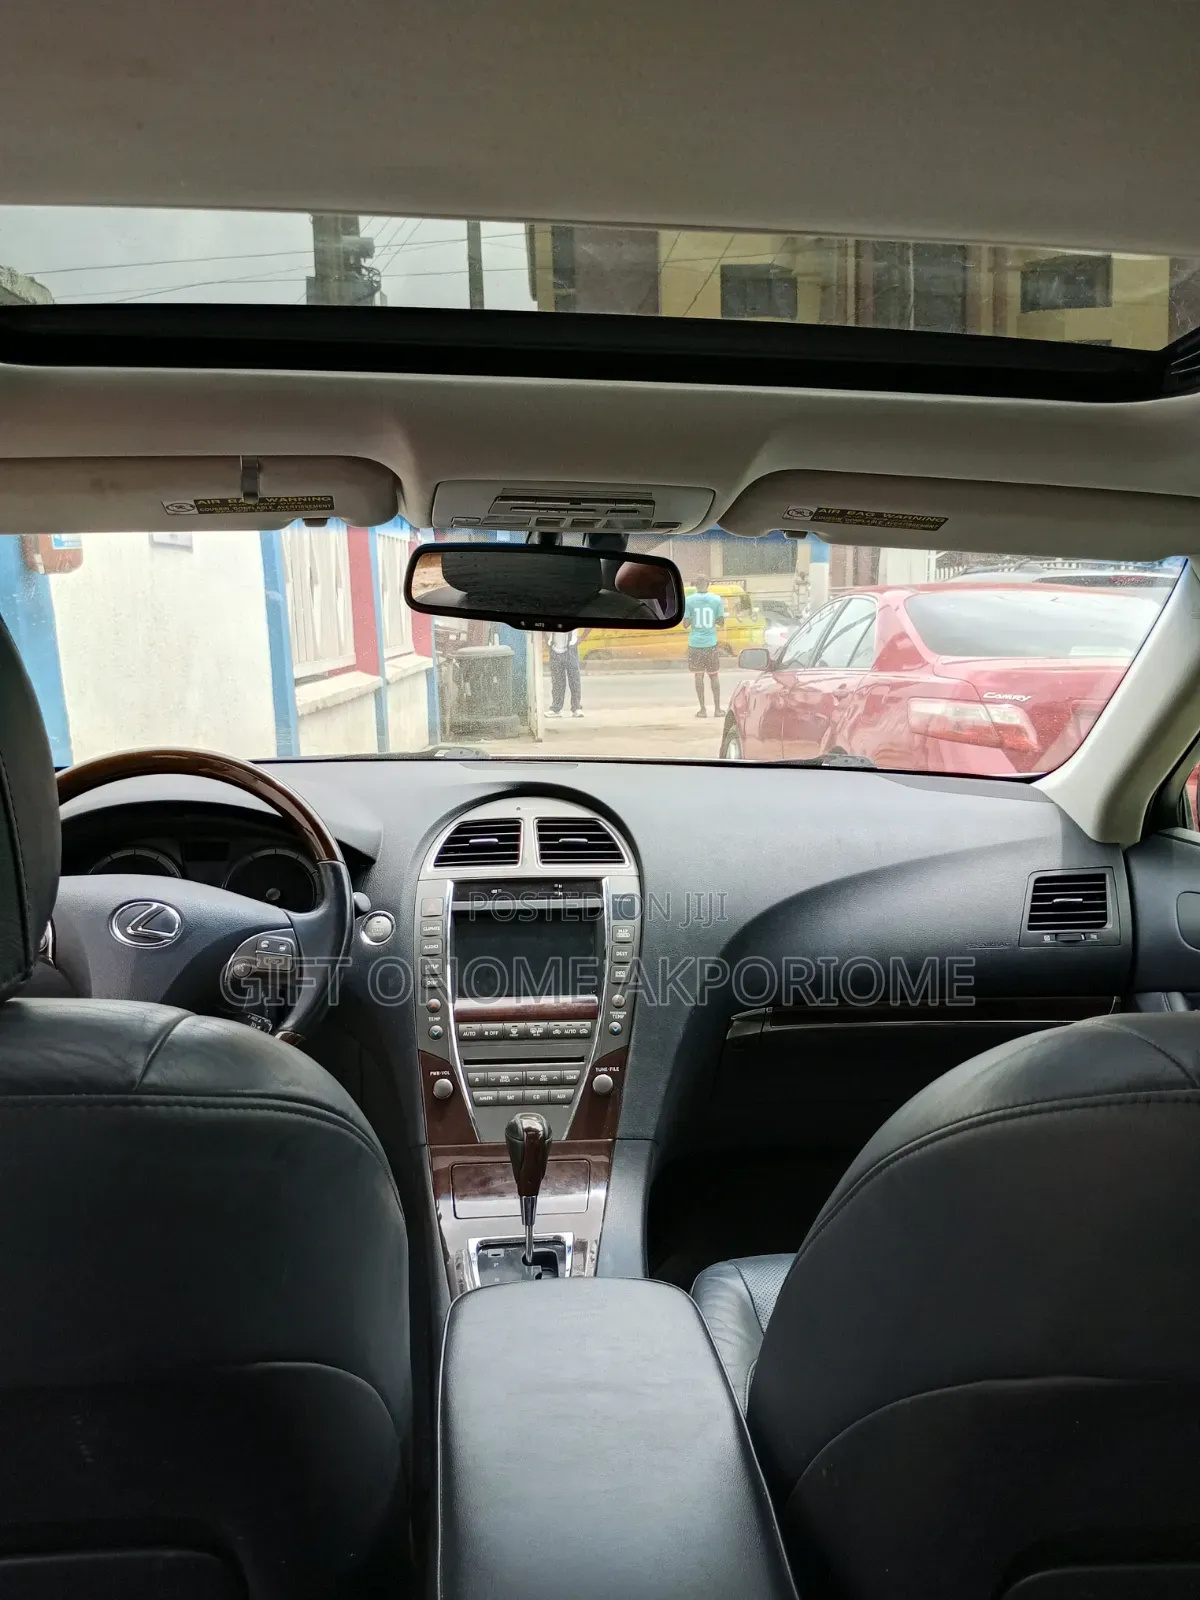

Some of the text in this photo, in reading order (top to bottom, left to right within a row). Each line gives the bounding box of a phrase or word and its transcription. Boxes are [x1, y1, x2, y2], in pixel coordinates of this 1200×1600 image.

[883, 513, 946, 523] WARNING
[694, 607, 714, 628] 10
[983, 691, 1032, 702] CAMRY
